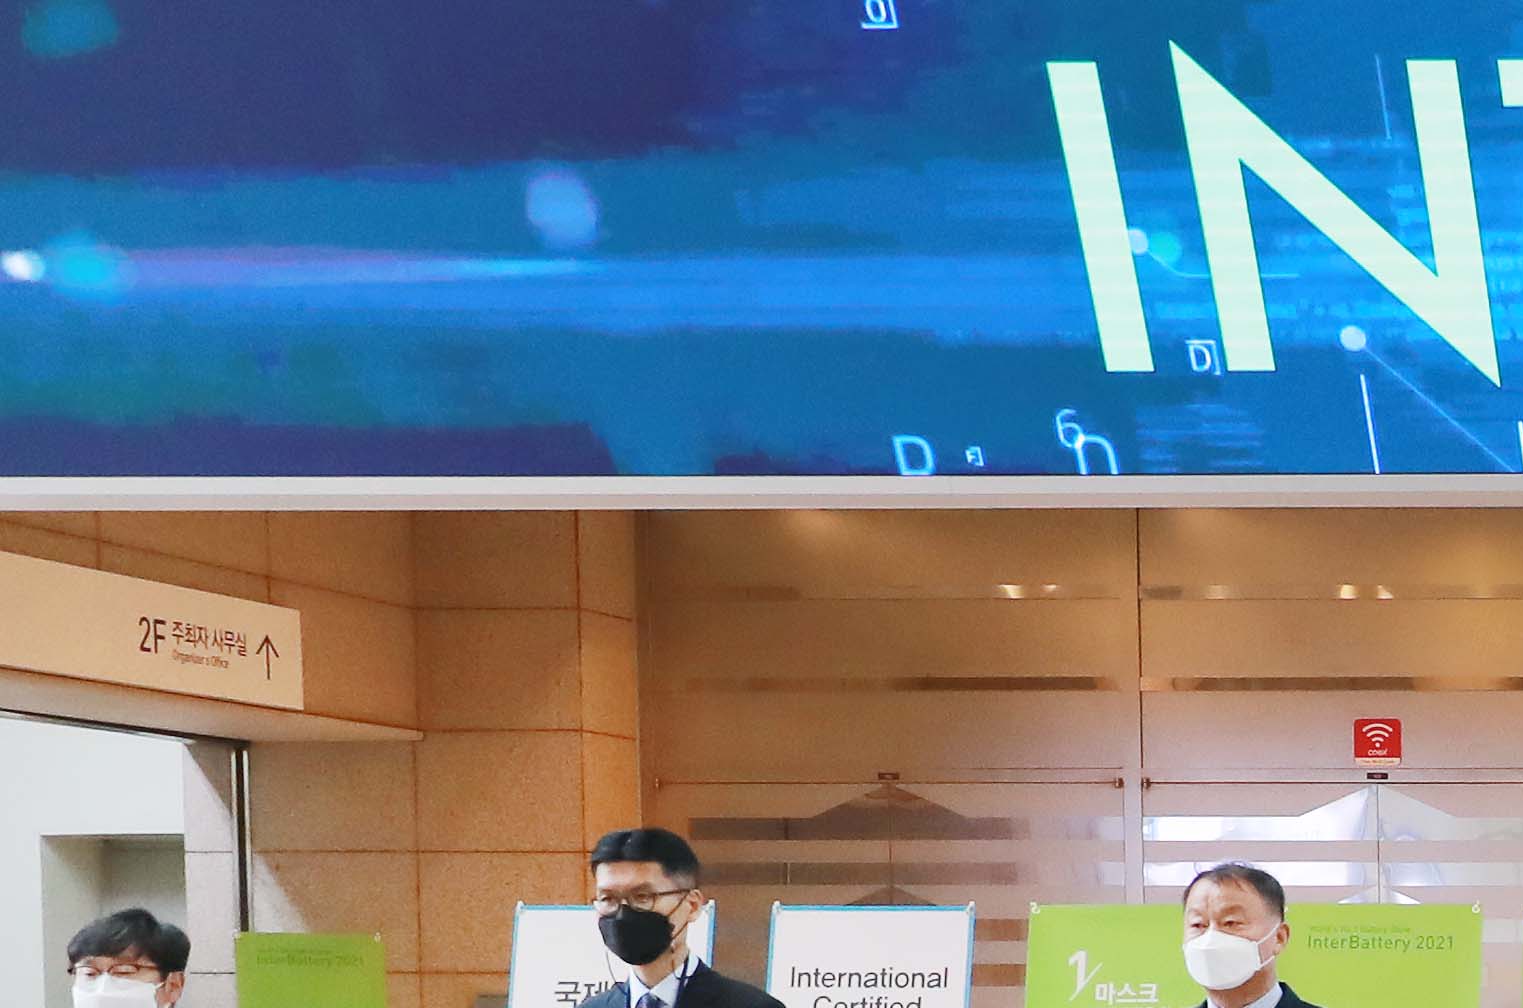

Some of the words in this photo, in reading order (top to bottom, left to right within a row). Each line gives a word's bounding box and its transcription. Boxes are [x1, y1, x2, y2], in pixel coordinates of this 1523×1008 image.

[138, 616, 166, 655] 2F
[171, 621, 208, 649] 주최자
[211, 628, 247, 657] 사무실
[1307, 934, 1410, 952] InterBattery
[1416, 935, 1455, 950] 2021
[790, 965, 949, 989] International
[1095, 982, 1160, 1005] 마스크
